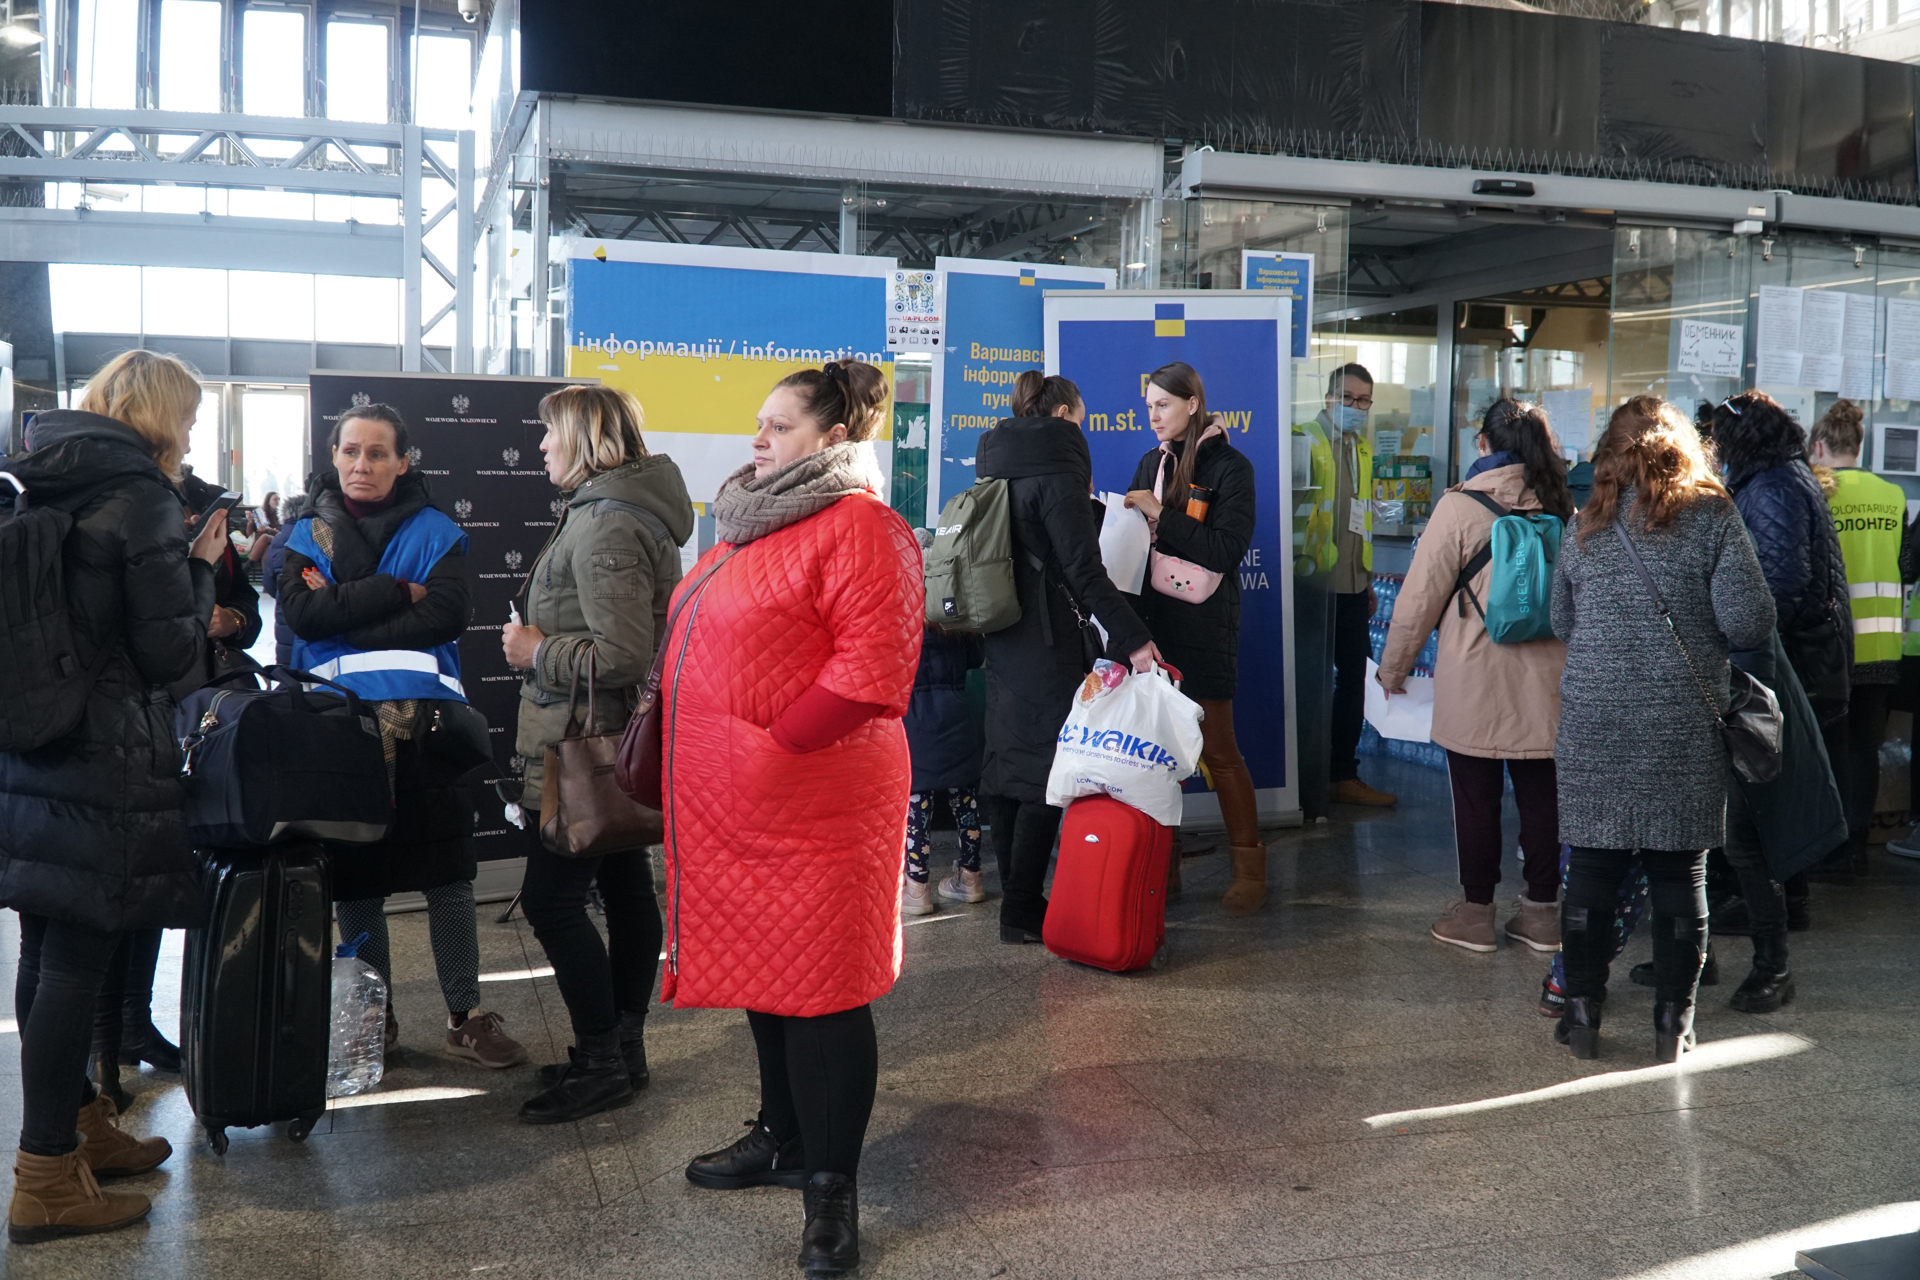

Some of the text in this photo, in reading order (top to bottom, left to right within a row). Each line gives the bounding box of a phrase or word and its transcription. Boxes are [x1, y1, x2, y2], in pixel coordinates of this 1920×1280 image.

[1684, 325, 1737, 340] ОБМЕННИК
[578, 331, 723, 363] інформації
[982, 392, 1012, 410] пун
[951, 413, 1008, 431] грома
[1830, 503, 1899, 516] OLONTARIUSZ
[1834, 517, 1898, 533] ОЛОНТЕР
[1515, 541, 1530, 613] SKECHERS
